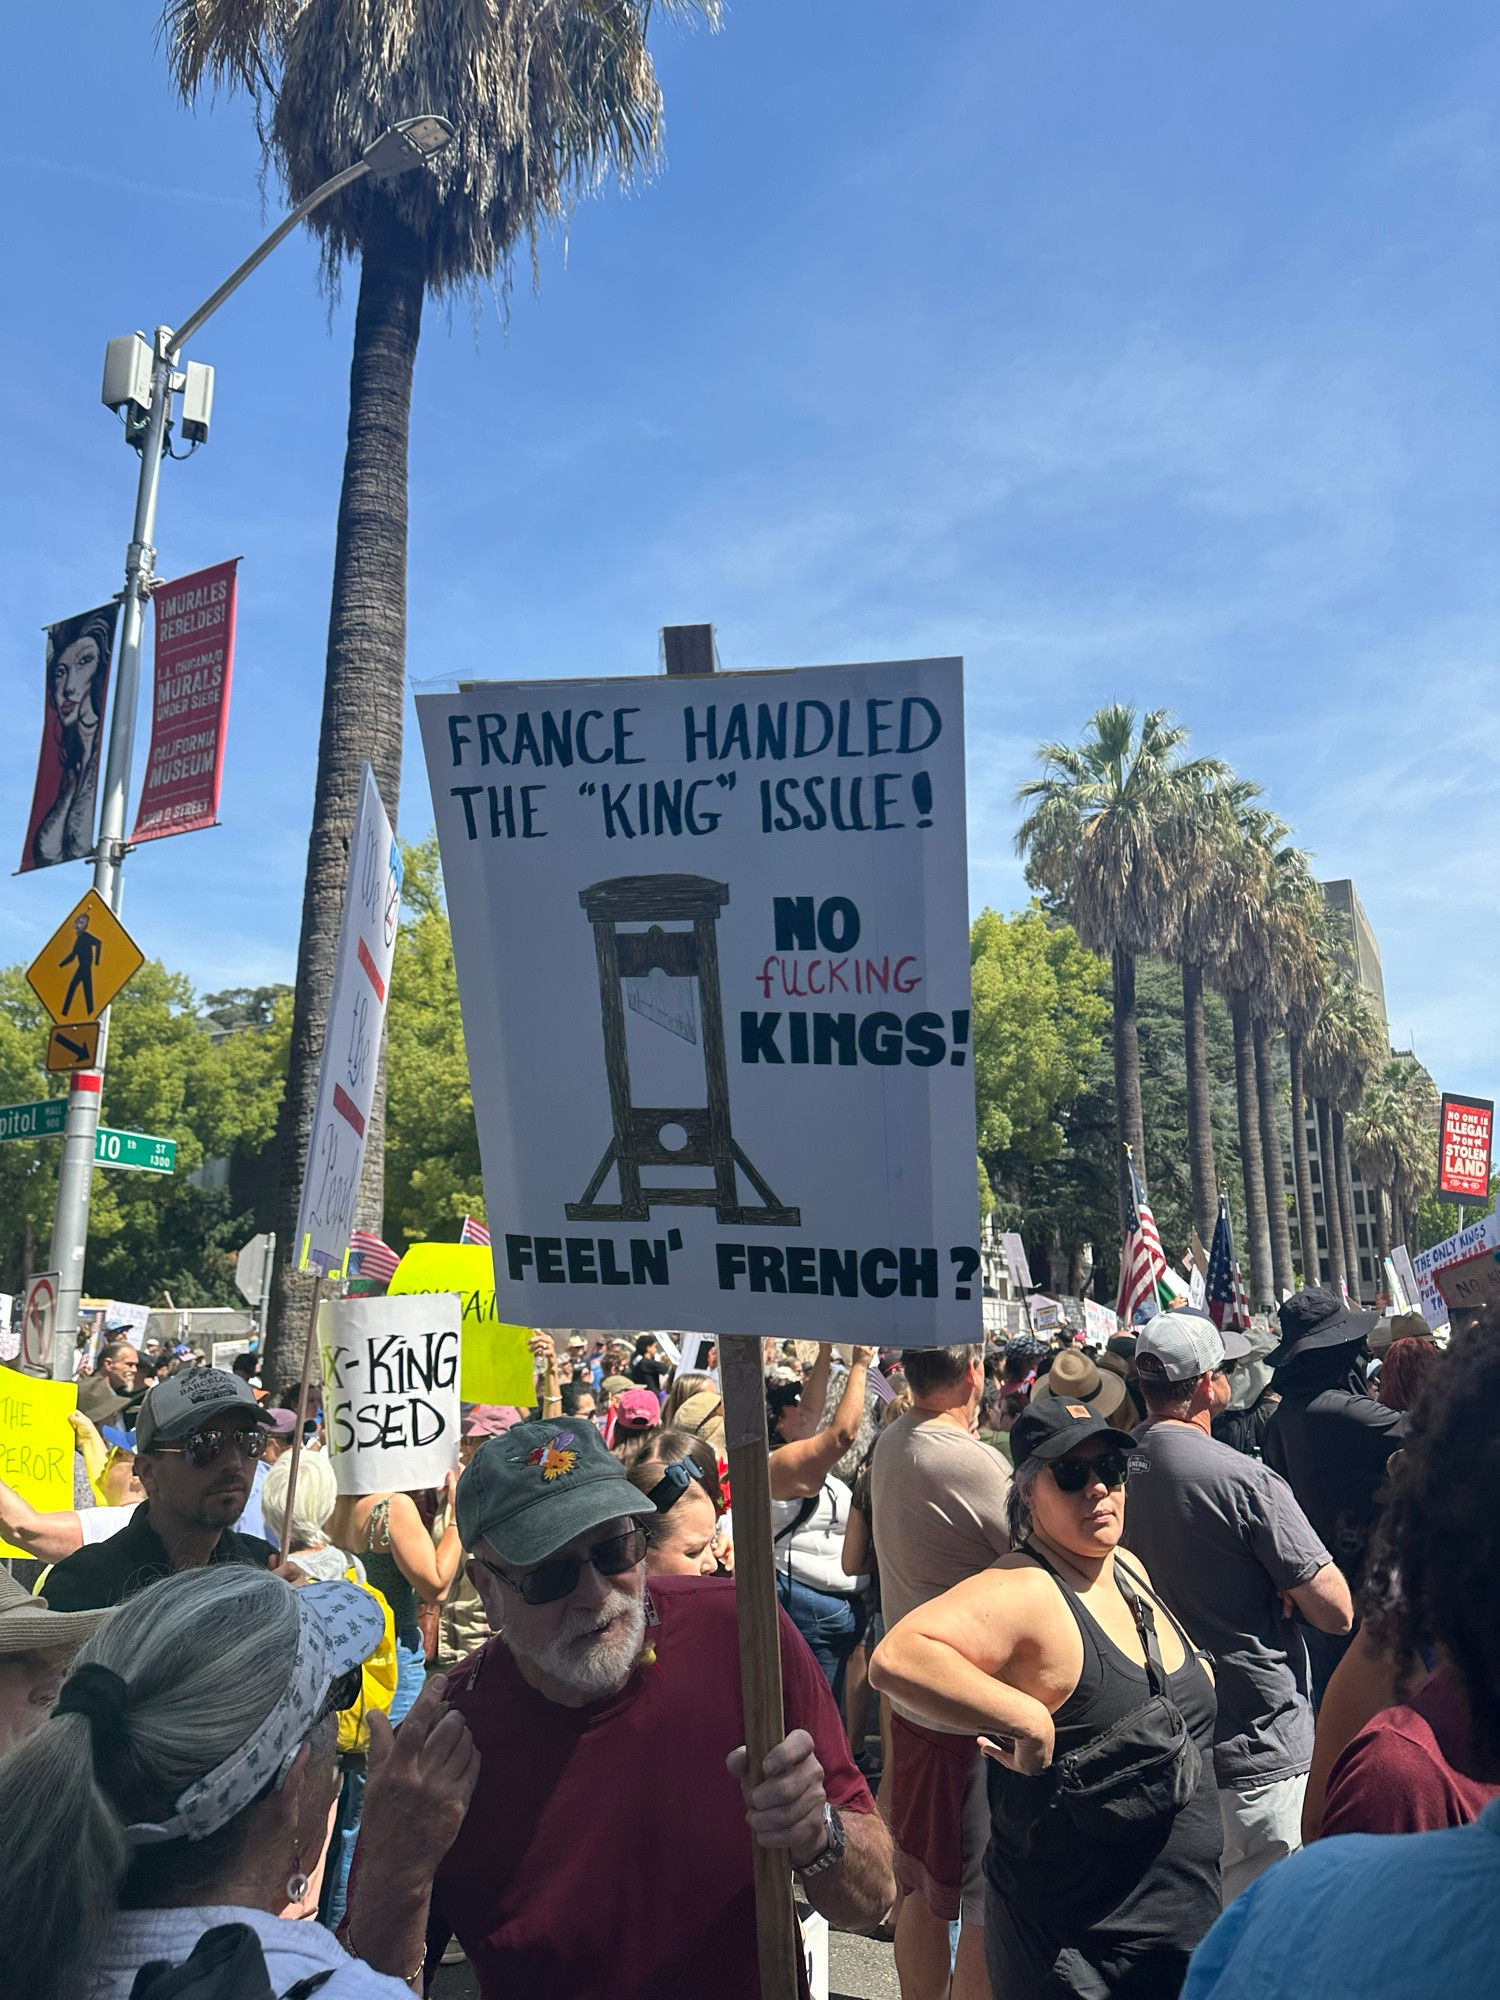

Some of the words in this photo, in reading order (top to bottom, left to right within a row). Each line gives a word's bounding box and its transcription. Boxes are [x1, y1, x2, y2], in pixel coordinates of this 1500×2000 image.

[160, 604, 226, 642] REBELDES!
[158, 664, 222, 704] MURALS
[157, 699, 189, 722] UNDER
[191, 689, 221, 709] SIEGE
[153, 729, 215, 763] CALIFORNIA
[448, 707, 646, 768] FRANCE
[683, 696, 943, 763] HANDLED
[149, 749, 215, 788] MUSEUM
[173, 798, 210, 819] STREET
[450, 785, 549, 840] THE
[760, 770, 935, 834] ISSUE!
[772, 896, 860, 953] NO
[740, 1010, 970, 1067] KINGS!
[1447, 1120, 1488, 1139] ILLEGAL
[1448, 1111, 1460, 1121] NO
[1462, 1114, 1478, 1124] ONE
[1480, 1117, 1488, 1126] IS
[100, 1134, 120, 1159] 10
[127, 1139, 137, 1149] th
[155, 1144, 166, 1154] ST
[1446, 1143, 1487, 1162] STOLEN
[1462, 1137, 1473, 1146] ON
[150, 1155, 171, 1168] 1300
[1445, 1156, 1486, 1178] LAND
[505, 1228, 683, 1285] FEELN'
[1415, 1253, 1431, 1273] THE
[1433, 1238, 1456, 1263] ONLY
[1459, 1224, 1486, 1249] KINGS
[1417, 1273, 1428, 1289] WE
[1456, 1279, 1480, 1298] NO
[4, 1396, 33, 1430] THE
